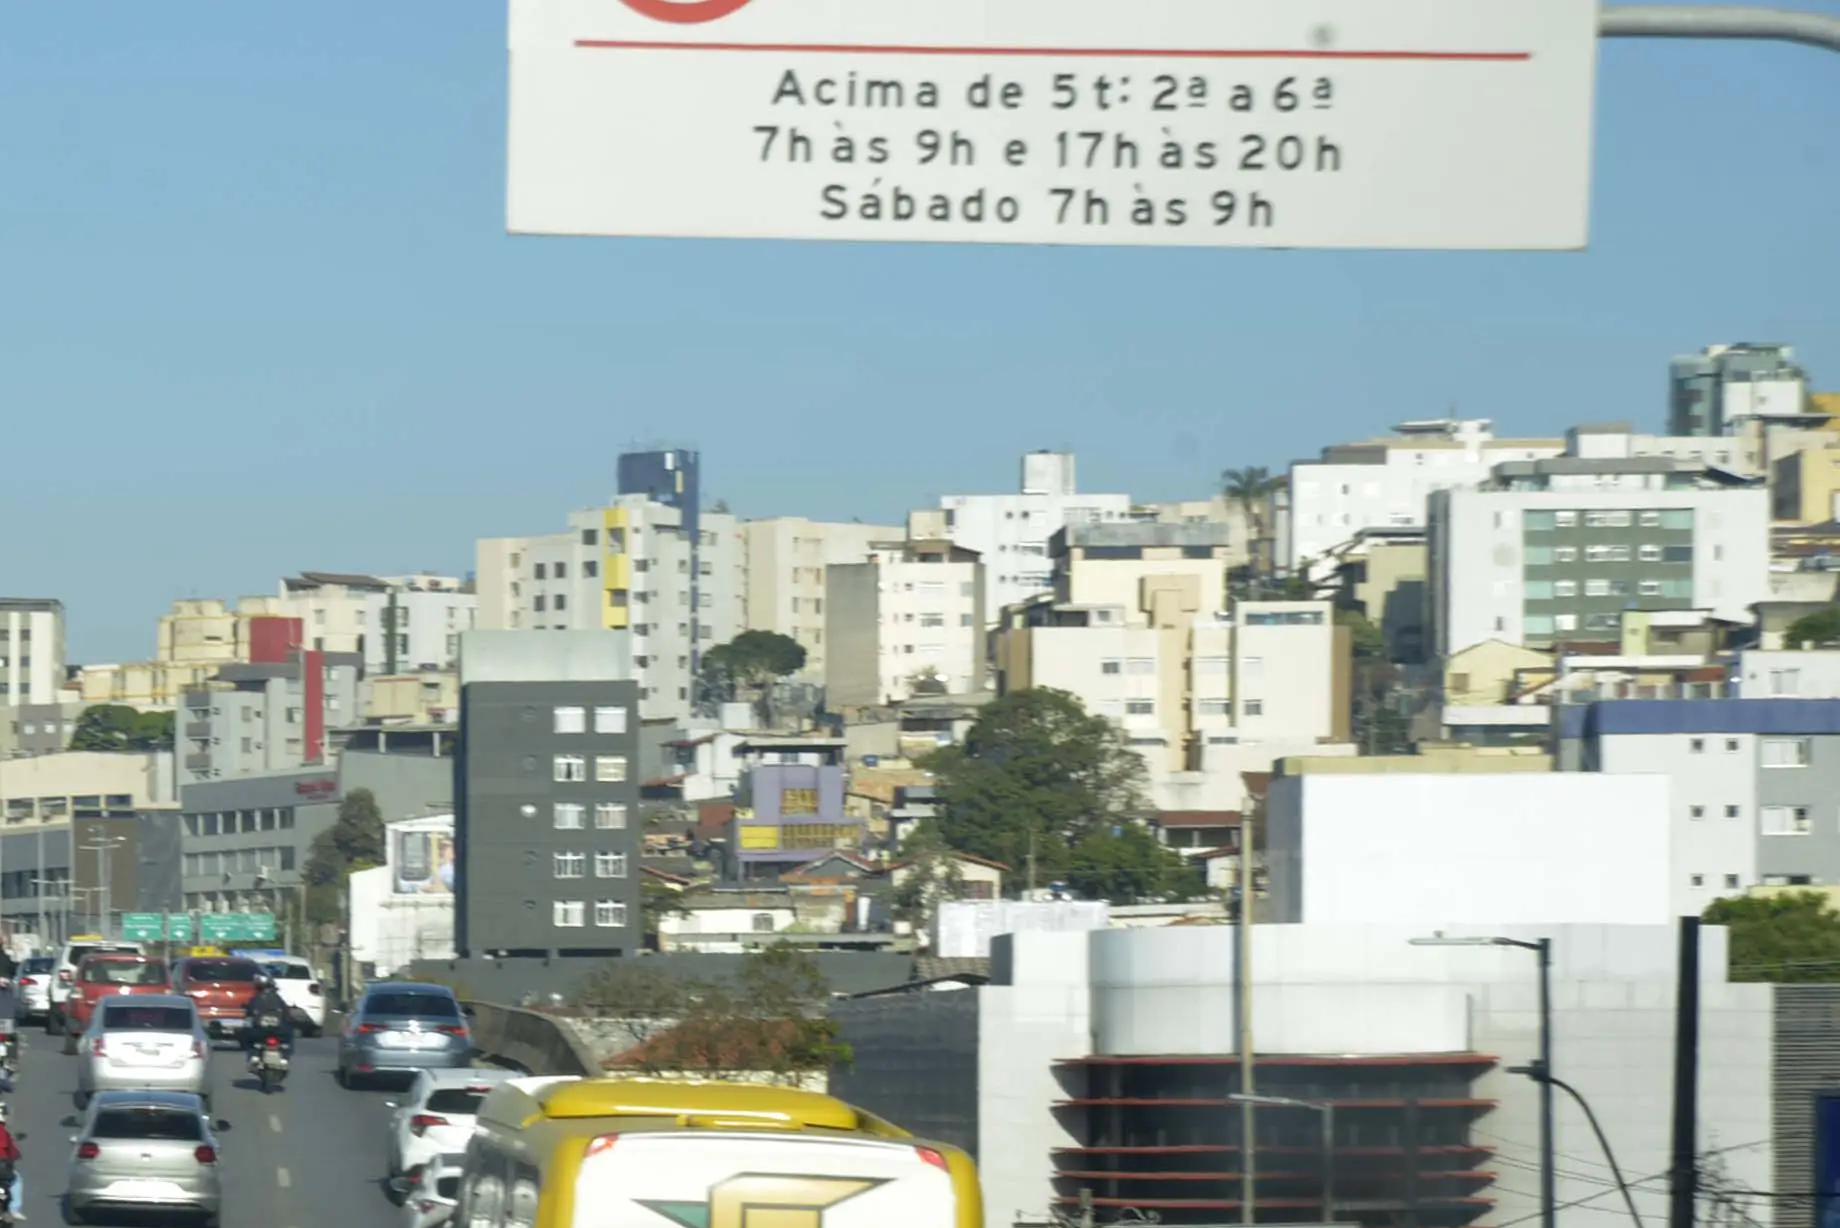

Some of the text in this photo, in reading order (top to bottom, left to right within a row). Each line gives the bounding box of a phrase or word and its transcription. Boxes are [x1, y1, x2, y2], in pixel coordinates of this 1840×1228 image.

[771, 69, 939, 108] Acima
[967, 74, 1024, 109] de
[1229, 84, 1254, 112] a
[753, 120, 1341, 171] 7h às 9h e 17h às 20h
[820, 177, 1273, 227] Sábado 7h às 9h
